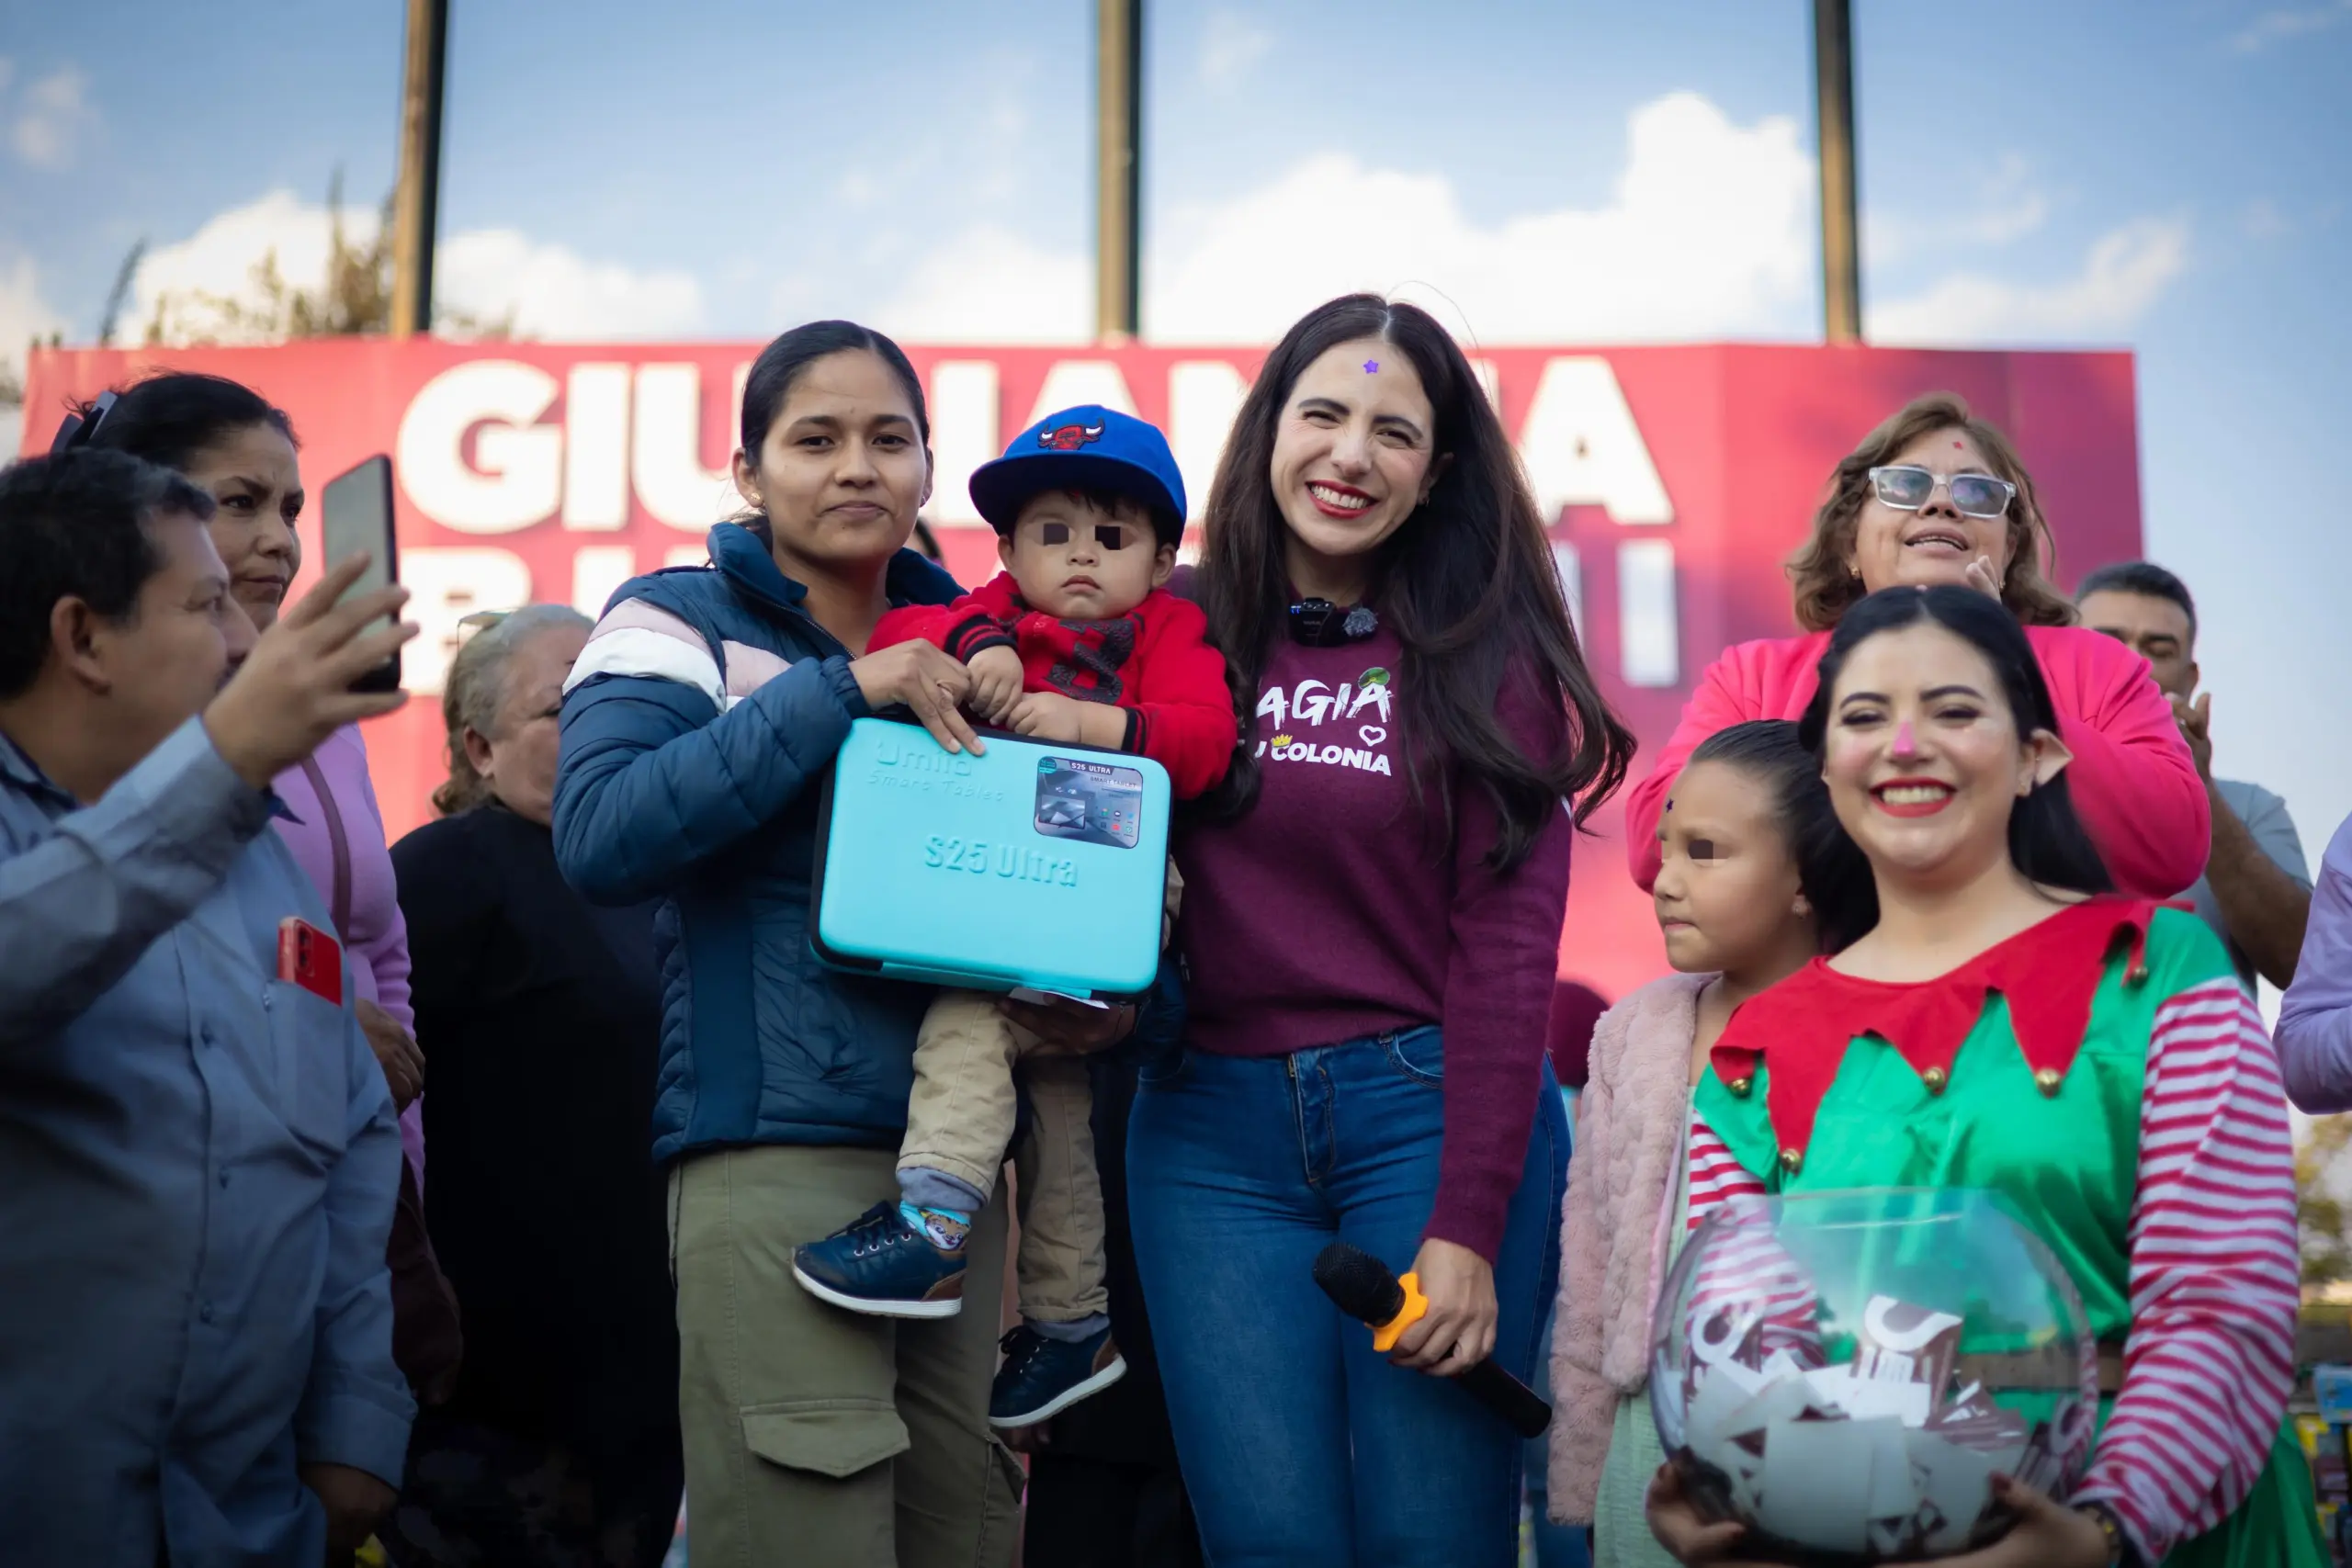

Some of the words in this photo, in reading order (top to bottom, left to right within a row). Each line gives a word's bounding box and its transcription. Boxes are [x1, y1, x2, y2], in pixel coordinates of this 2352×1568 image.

[1255, 679, 1395, 731] AGIA
[1070, 761, 1086, 772] S25
[1088, 765, 1111, 774] ULTRA
[1271, 742, 1392, 777] COLONIA
[924, 835, 989, 874] S25
[995, 844, 1079, 887] Ultra
